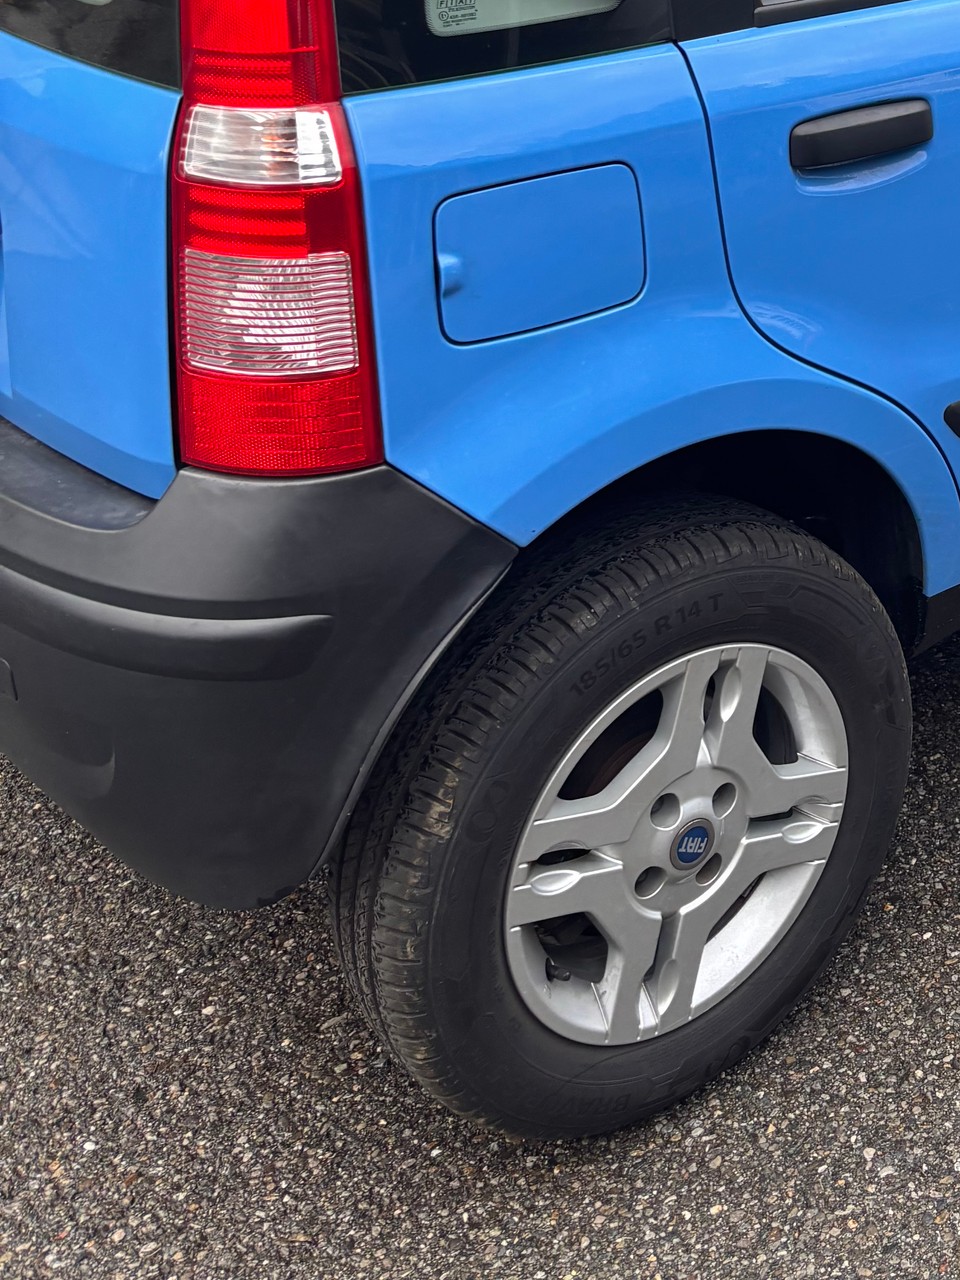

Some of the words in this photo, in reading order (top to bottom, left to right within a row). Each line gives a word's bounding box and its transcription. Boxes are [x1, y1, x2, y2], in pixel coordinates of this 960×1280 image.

[569, 628, 647, 697] 185/65
[655, 616, 673, 636] R
[676, 600, 703, 624] 14
[708, 592, 725, 613] T
[678, 836, 708, 853] FIAT
